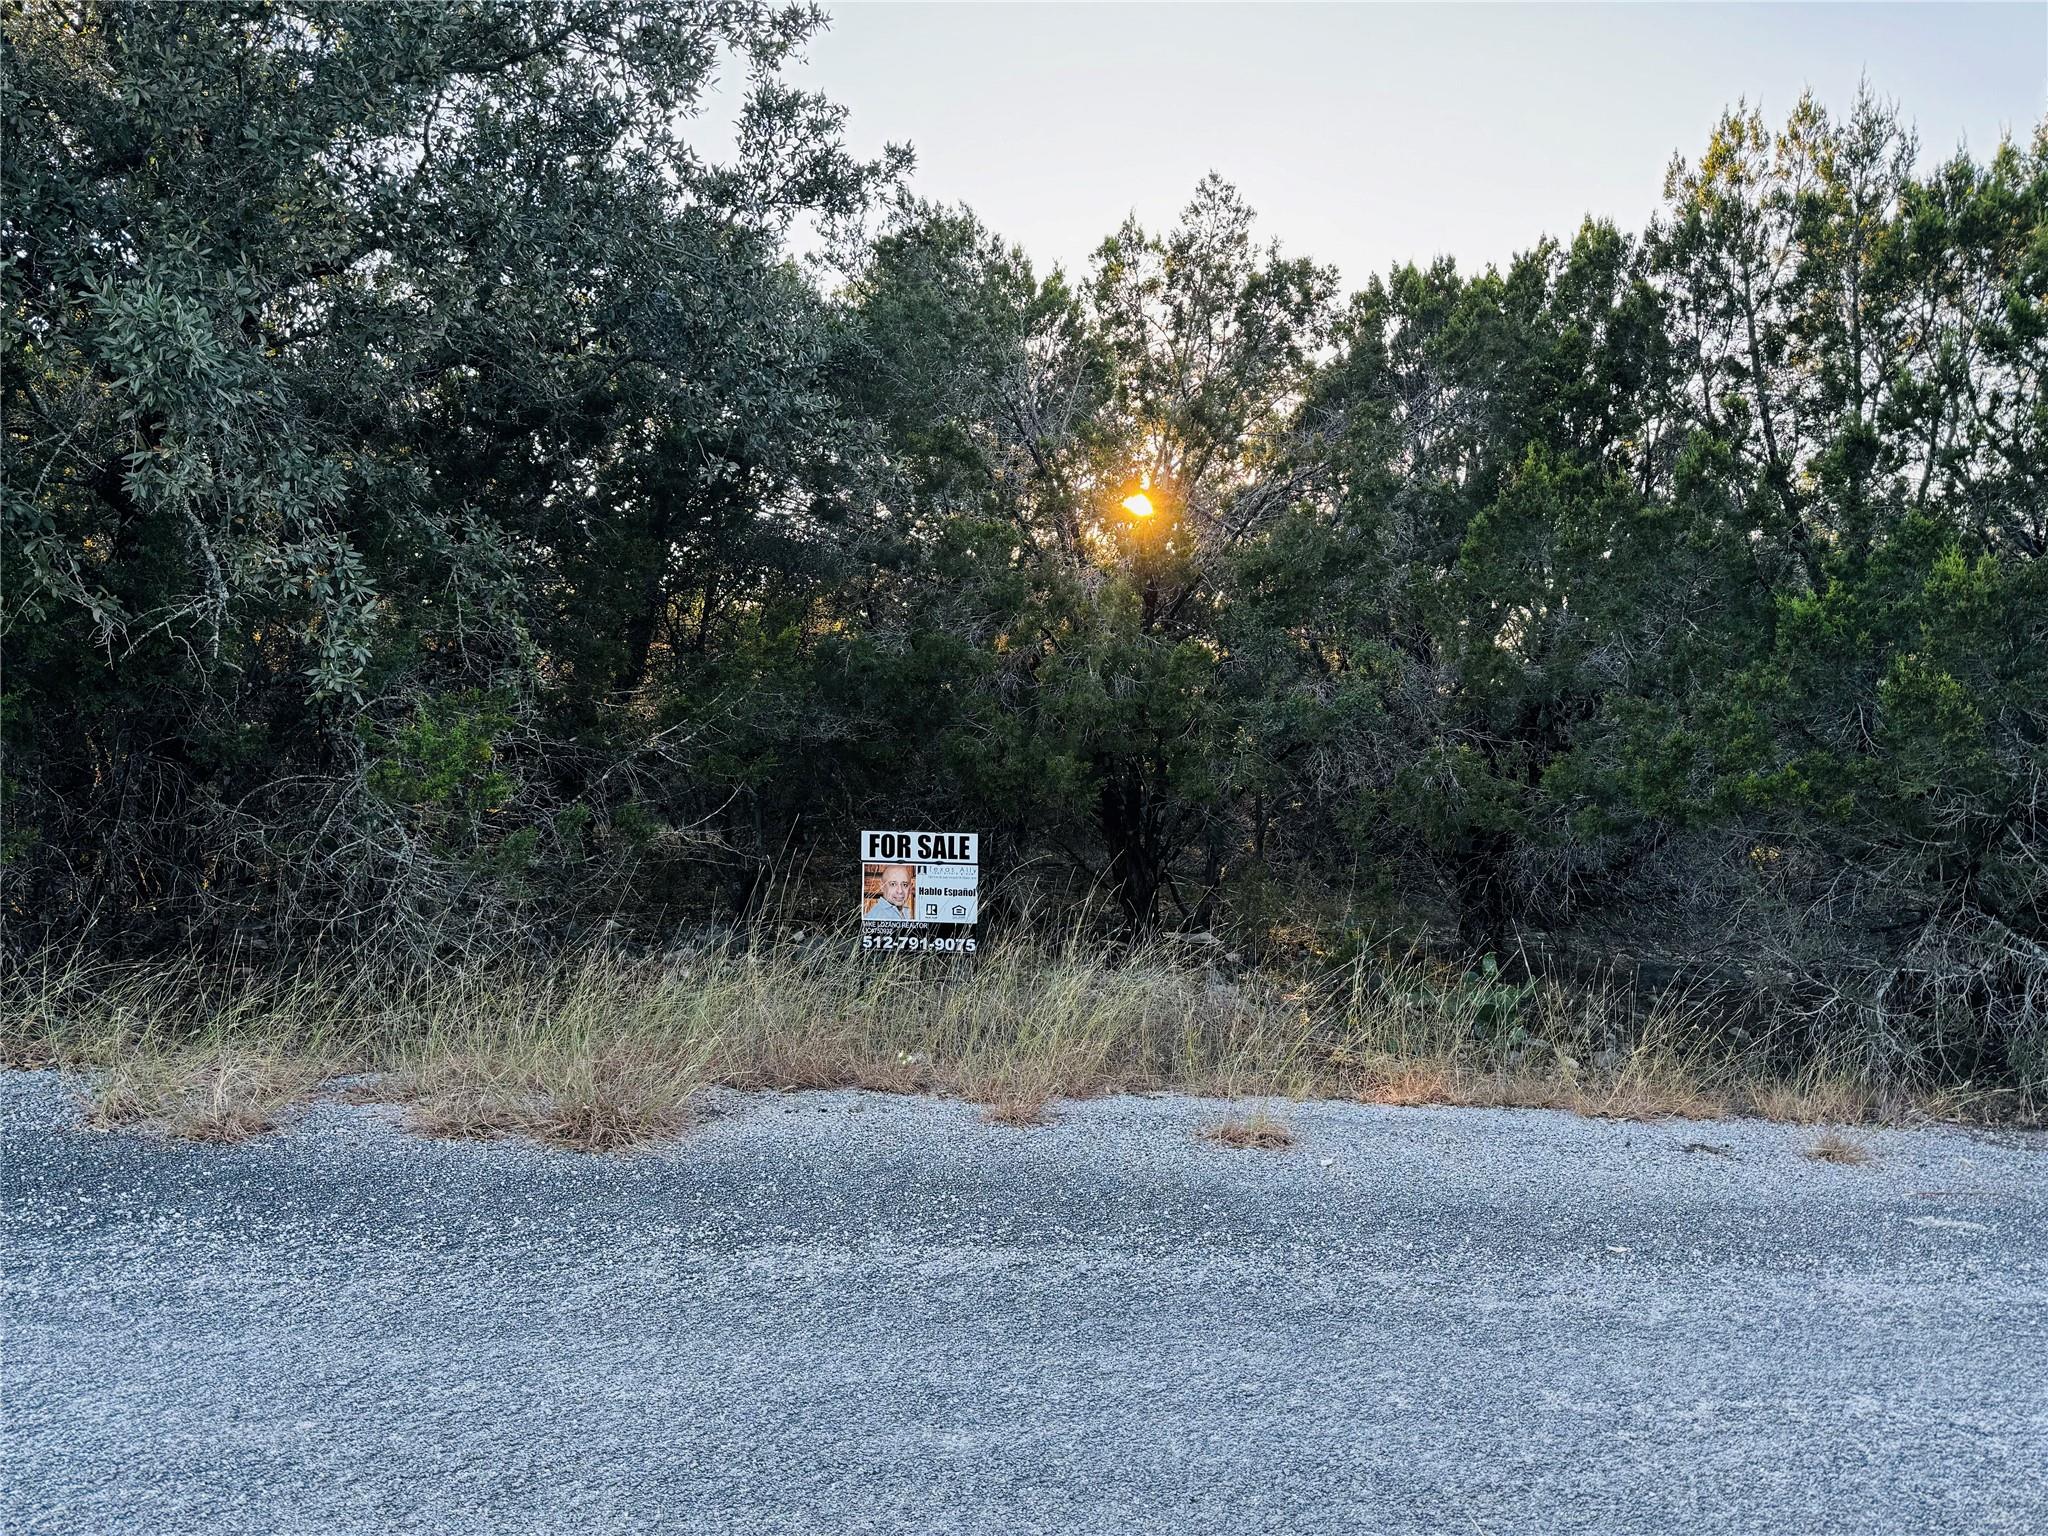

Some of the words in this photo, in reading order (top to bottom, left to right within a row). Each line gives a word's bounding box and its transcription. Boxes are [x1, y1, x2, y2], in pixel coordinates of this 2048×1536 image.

[869, 834, 911, 858] FOR
[917, 834, 970, 860] SALE
[919, 886, 942, 896] Hablo
[944, 887, 976, 897] Español
[862, 936, 976, 951] 512-791-9075
